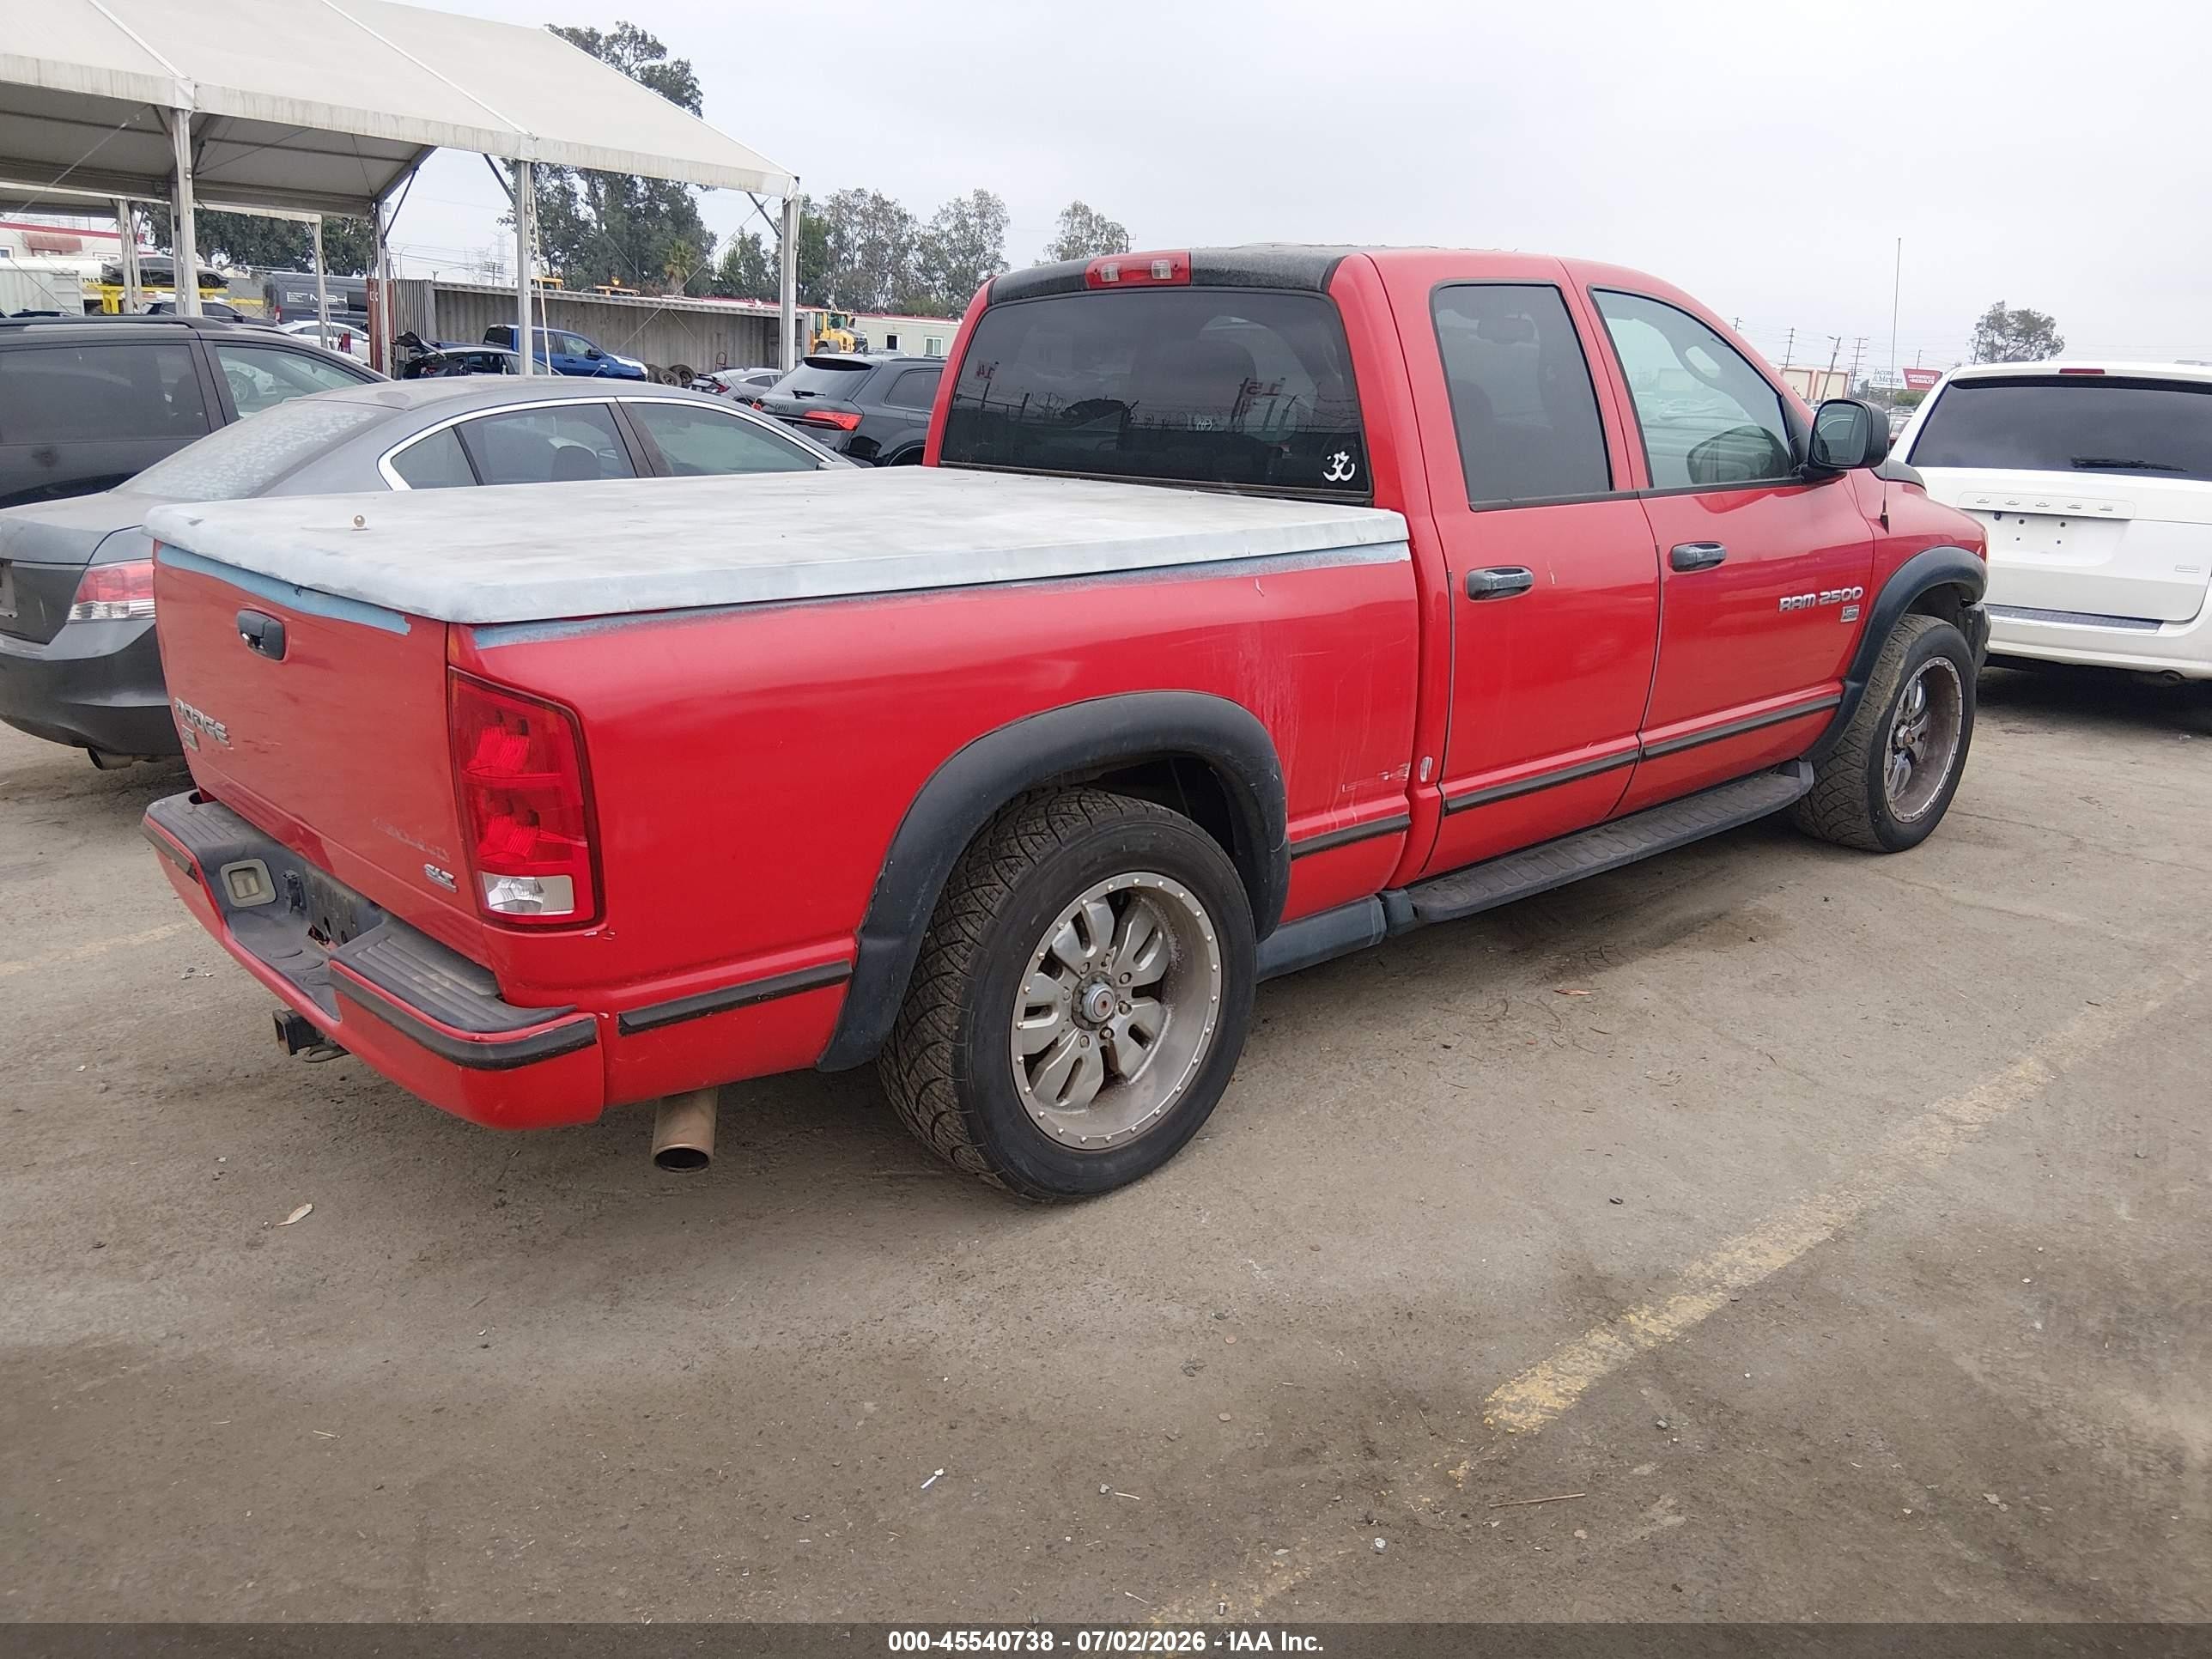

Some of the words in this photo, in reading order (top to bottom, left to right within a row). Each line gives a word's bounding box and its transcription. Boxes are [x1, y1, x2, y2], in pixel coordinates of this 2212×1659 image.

[1779, 592, 1816, 611] RAM
[1819, 586, 1863, 605] 2500
[173, 696, 229, 746] DODGE
